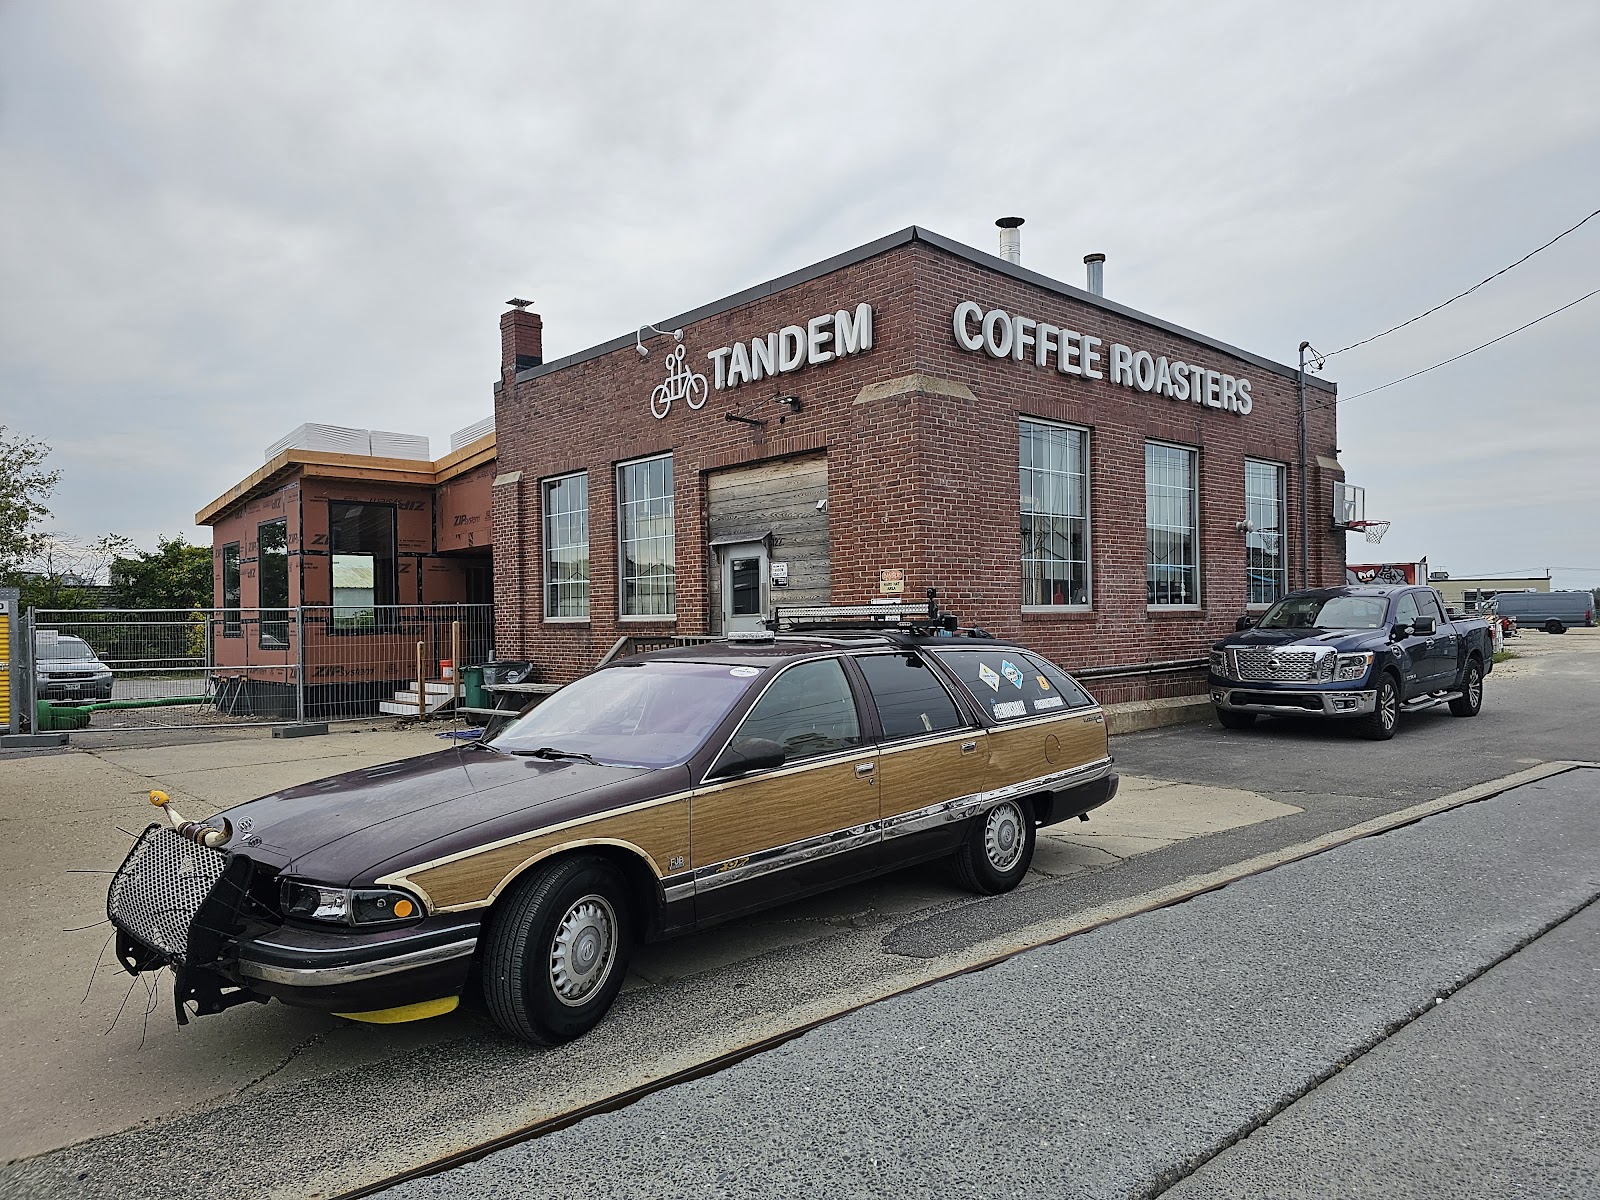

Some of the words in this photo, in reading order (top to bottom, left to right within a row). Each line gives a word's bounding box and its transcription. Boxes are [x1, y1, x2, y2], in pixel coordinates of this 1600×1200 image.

[707, 302, 874, 391] TANDEM
[952, 300, 1104, 380] COFFEE
[1110, 343, 1254, 416] ROASTERS
